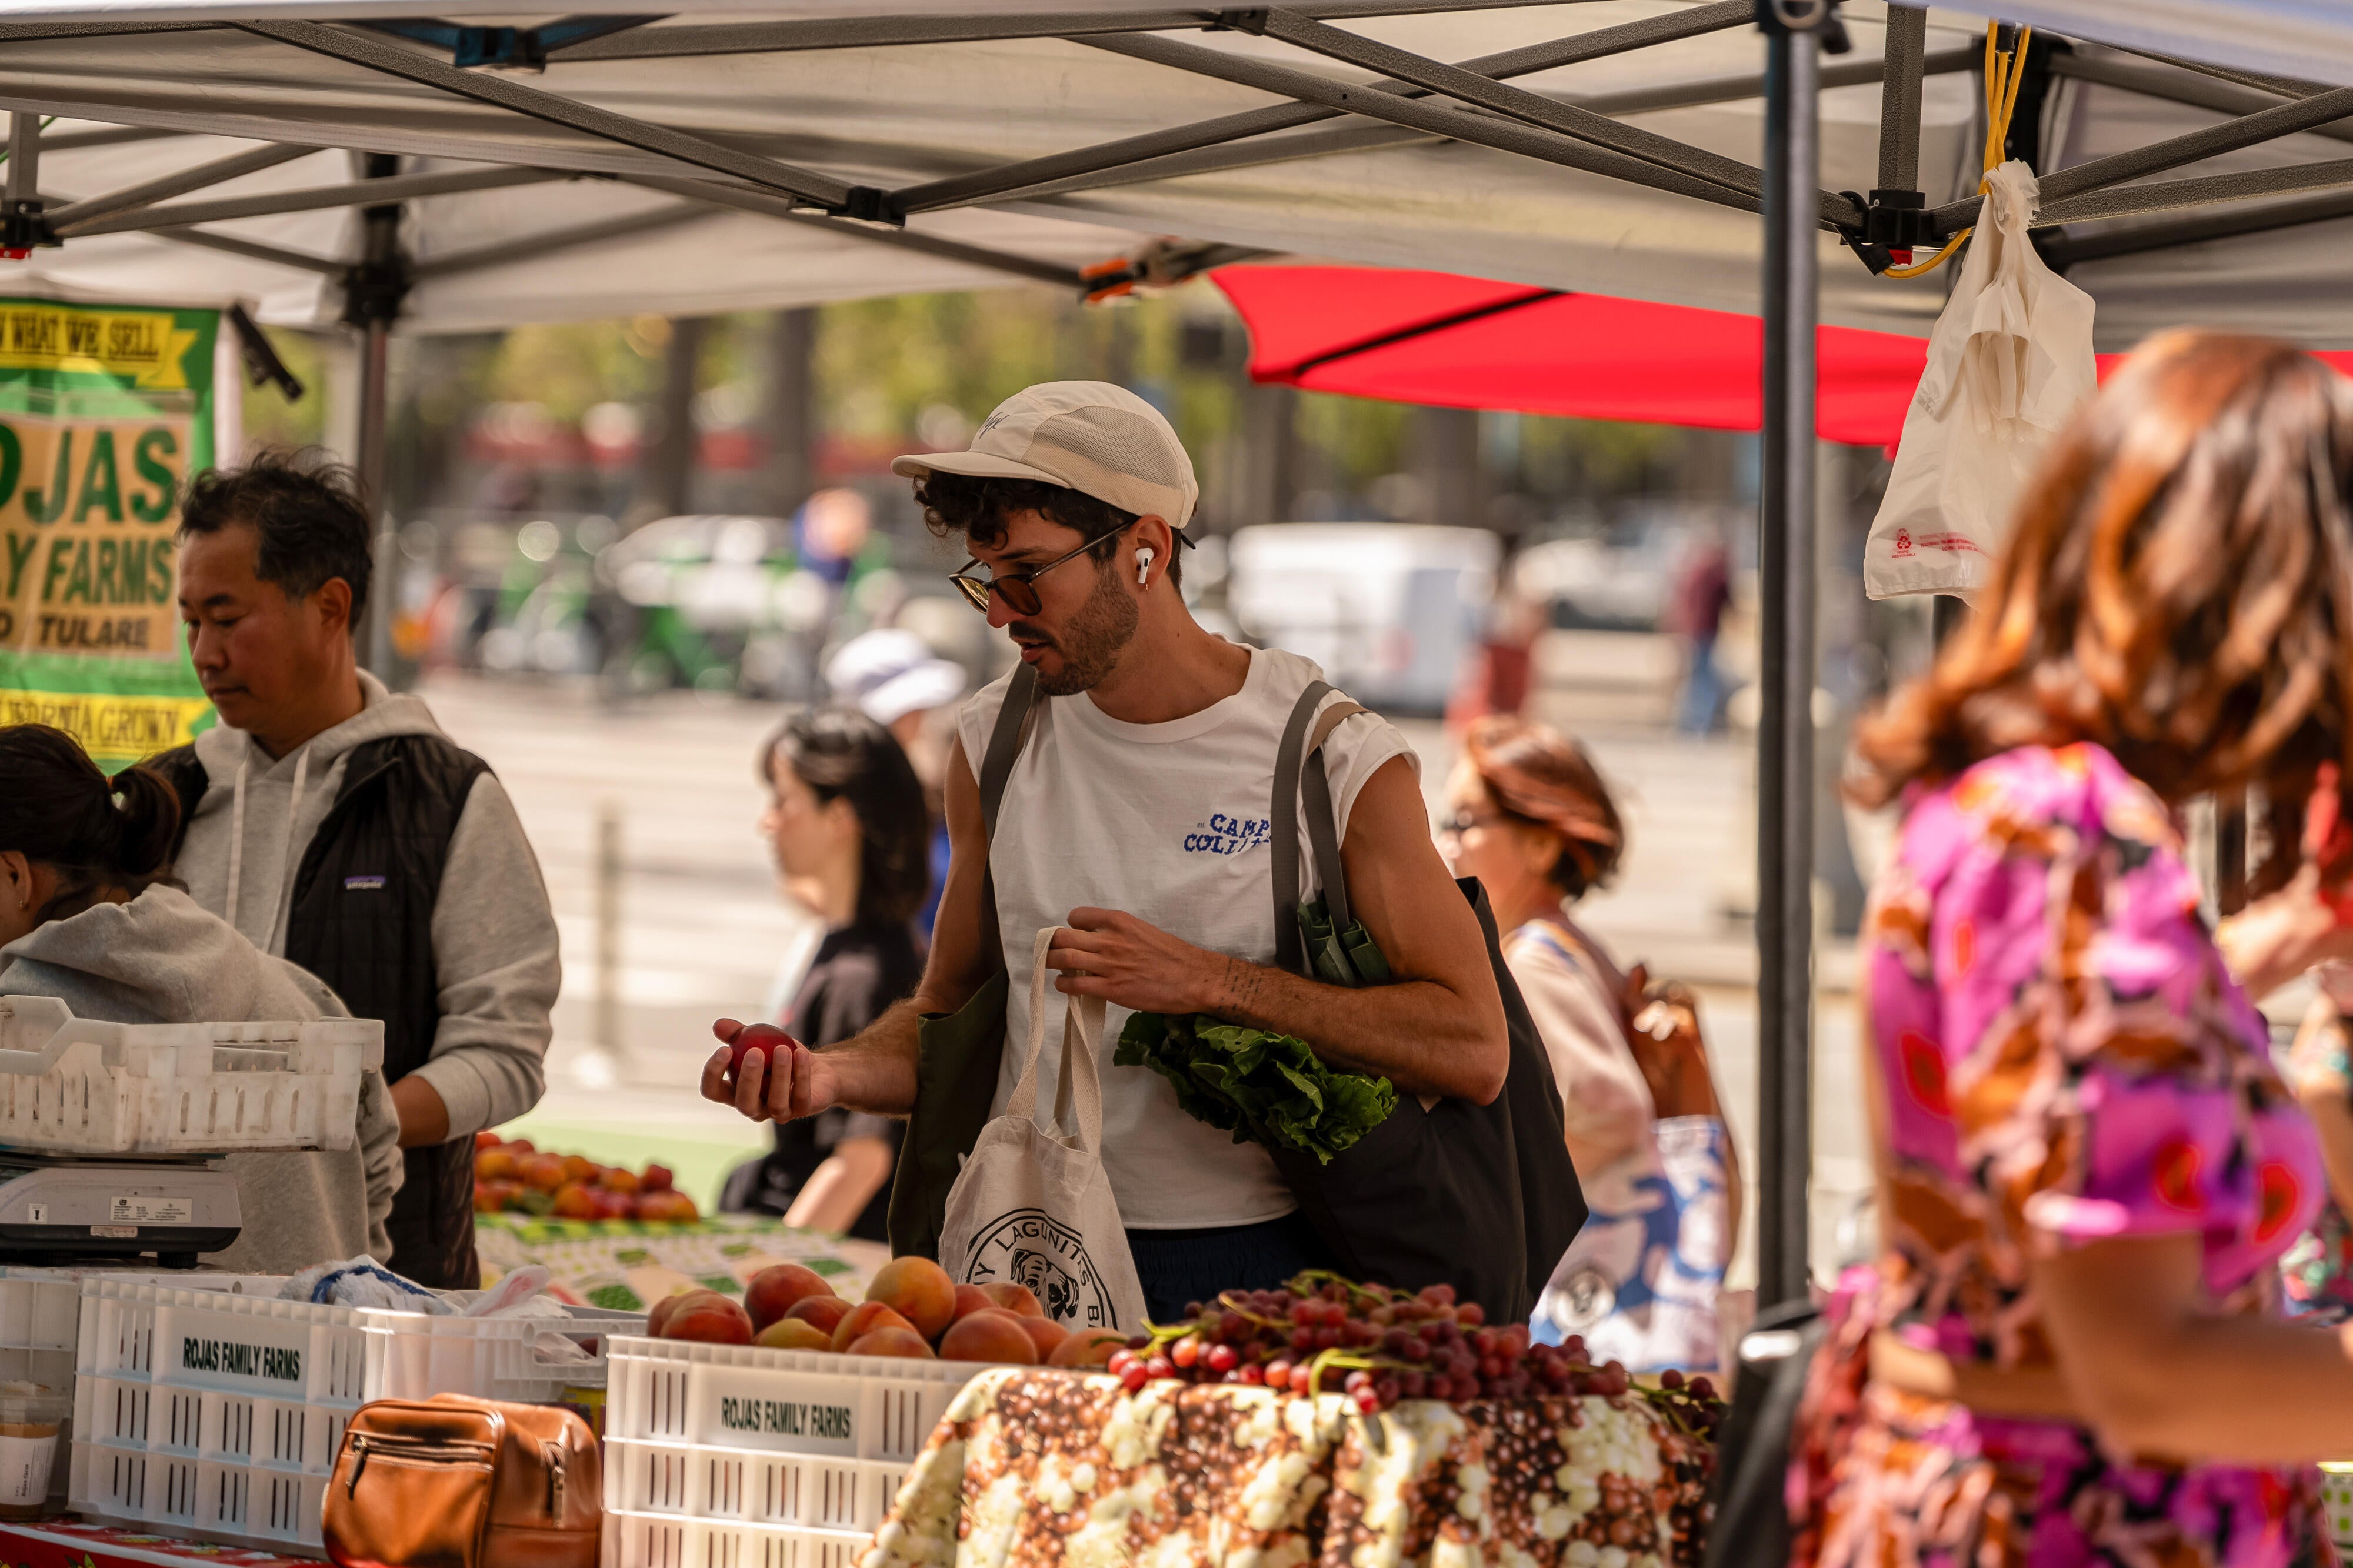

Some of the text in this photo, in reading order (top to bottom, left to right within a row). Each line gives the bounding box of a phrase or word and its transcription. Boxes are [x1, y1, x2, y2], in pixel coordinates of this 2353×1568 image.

[66, 318, 100, 354] WE
[42, 536, 172, 606] FARMS
[39, 613, 149, 649] TULARE
[1209, 814, 1270, 838] CAMP
[183, 1337, 301, 1382] ROJAS FAMILY FARMS
[721, 1396, 851, 1439] ROJAS FAMILY FARMS
